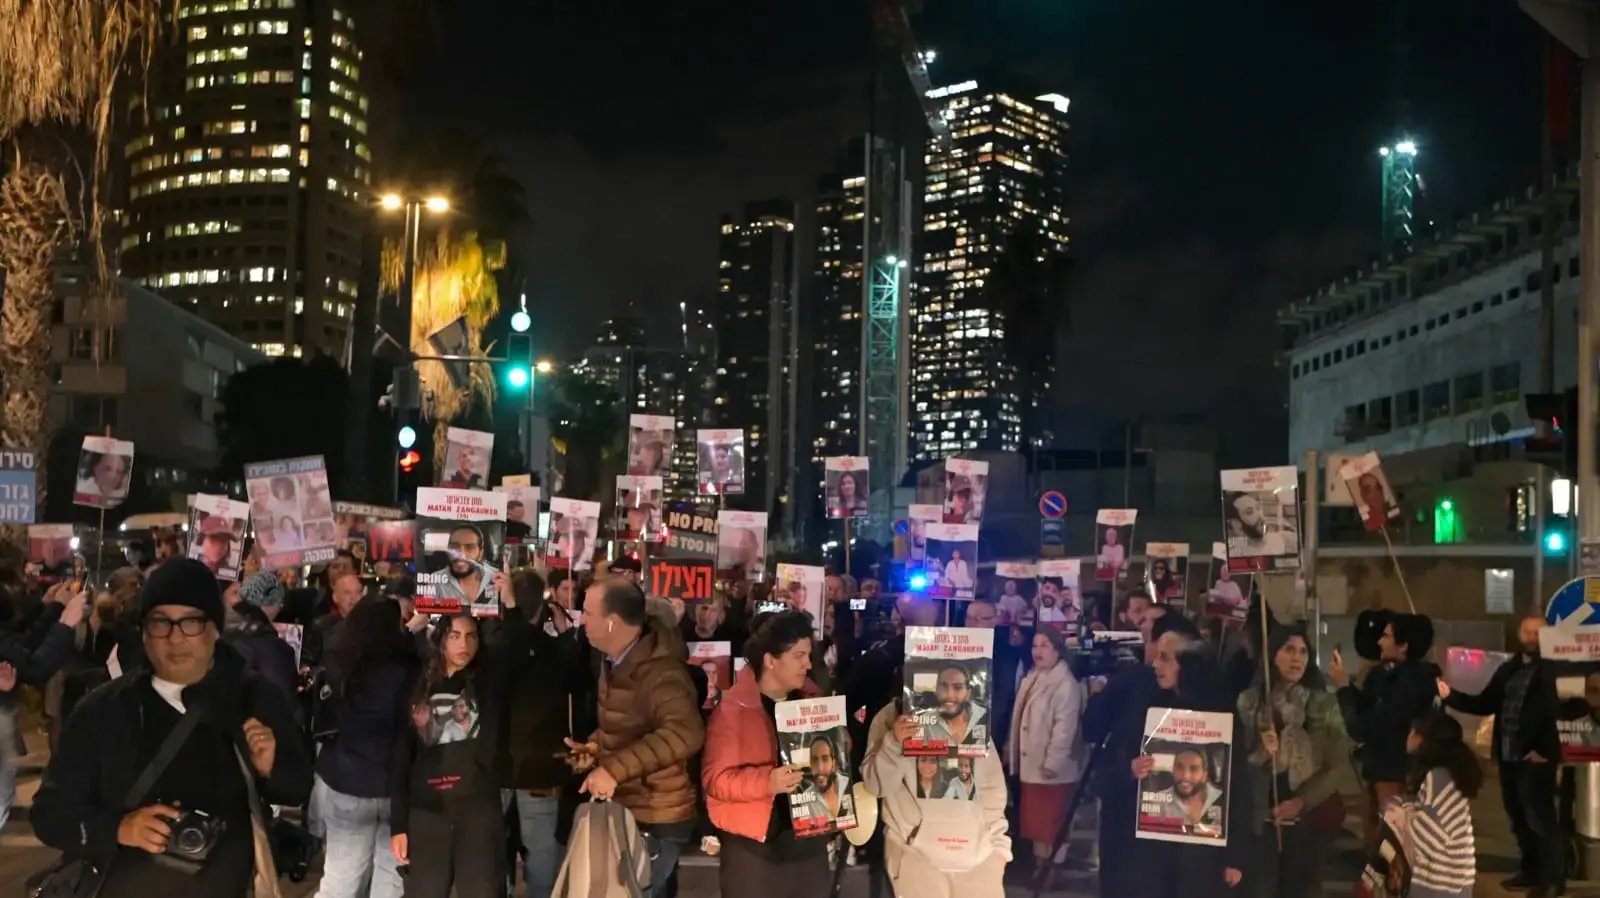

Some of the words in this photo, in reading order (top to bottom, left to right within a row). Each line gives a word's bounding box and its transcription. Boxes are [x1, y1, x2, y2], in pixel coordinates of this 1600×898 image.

[427, 504, 452, 513] MATAN
[669, 511, 691, 529] NO
[679, 536, 703, 552] TOO
[416, 573, 449, 584] BRING
[651, 561, 712, 600] הצילו
[416, 585, 437, 596] HIM
[906, 715, 937, 726] RING
[790, 791, 817, 806] BRING
[1142, 791, 1173, 803] BRING
[792, 805, 811, 819] HIM
[1142, 803, 1161, 814] HIM
